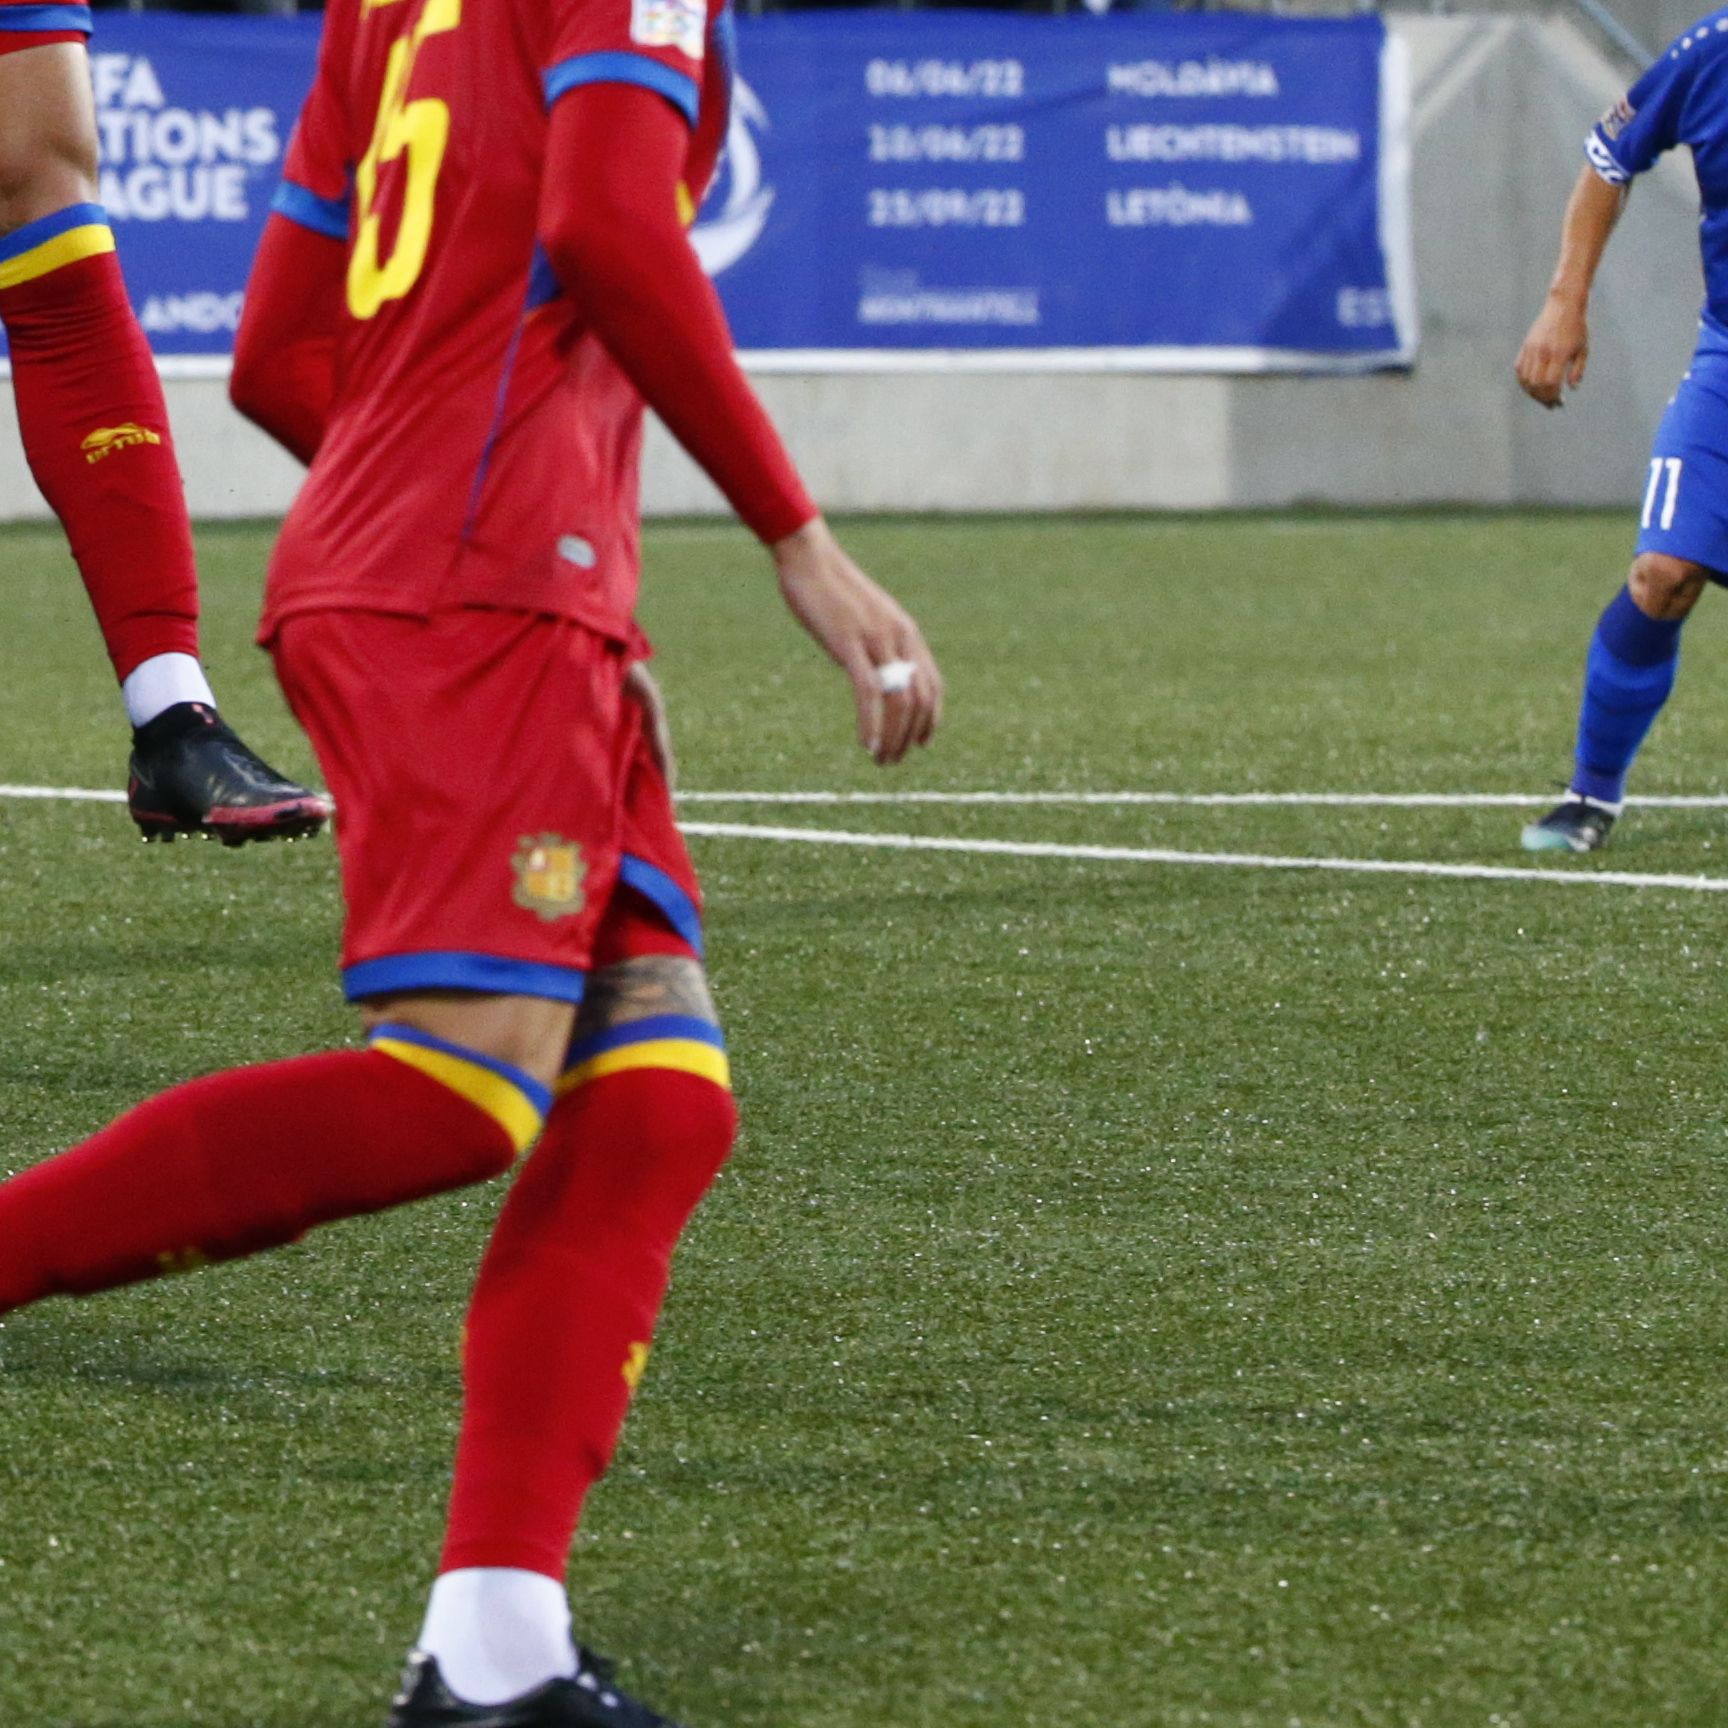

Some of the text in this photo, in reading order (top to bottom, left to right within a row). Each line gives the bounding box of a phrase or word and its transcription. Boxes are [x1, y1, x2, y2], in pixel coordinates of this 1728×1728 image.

[93, 53, 166, 109] FA
[96, 108, 280, 164] TIONS
[99, 163, 251, 221] AGUE
[1641, 457, 1683, 531] 11
